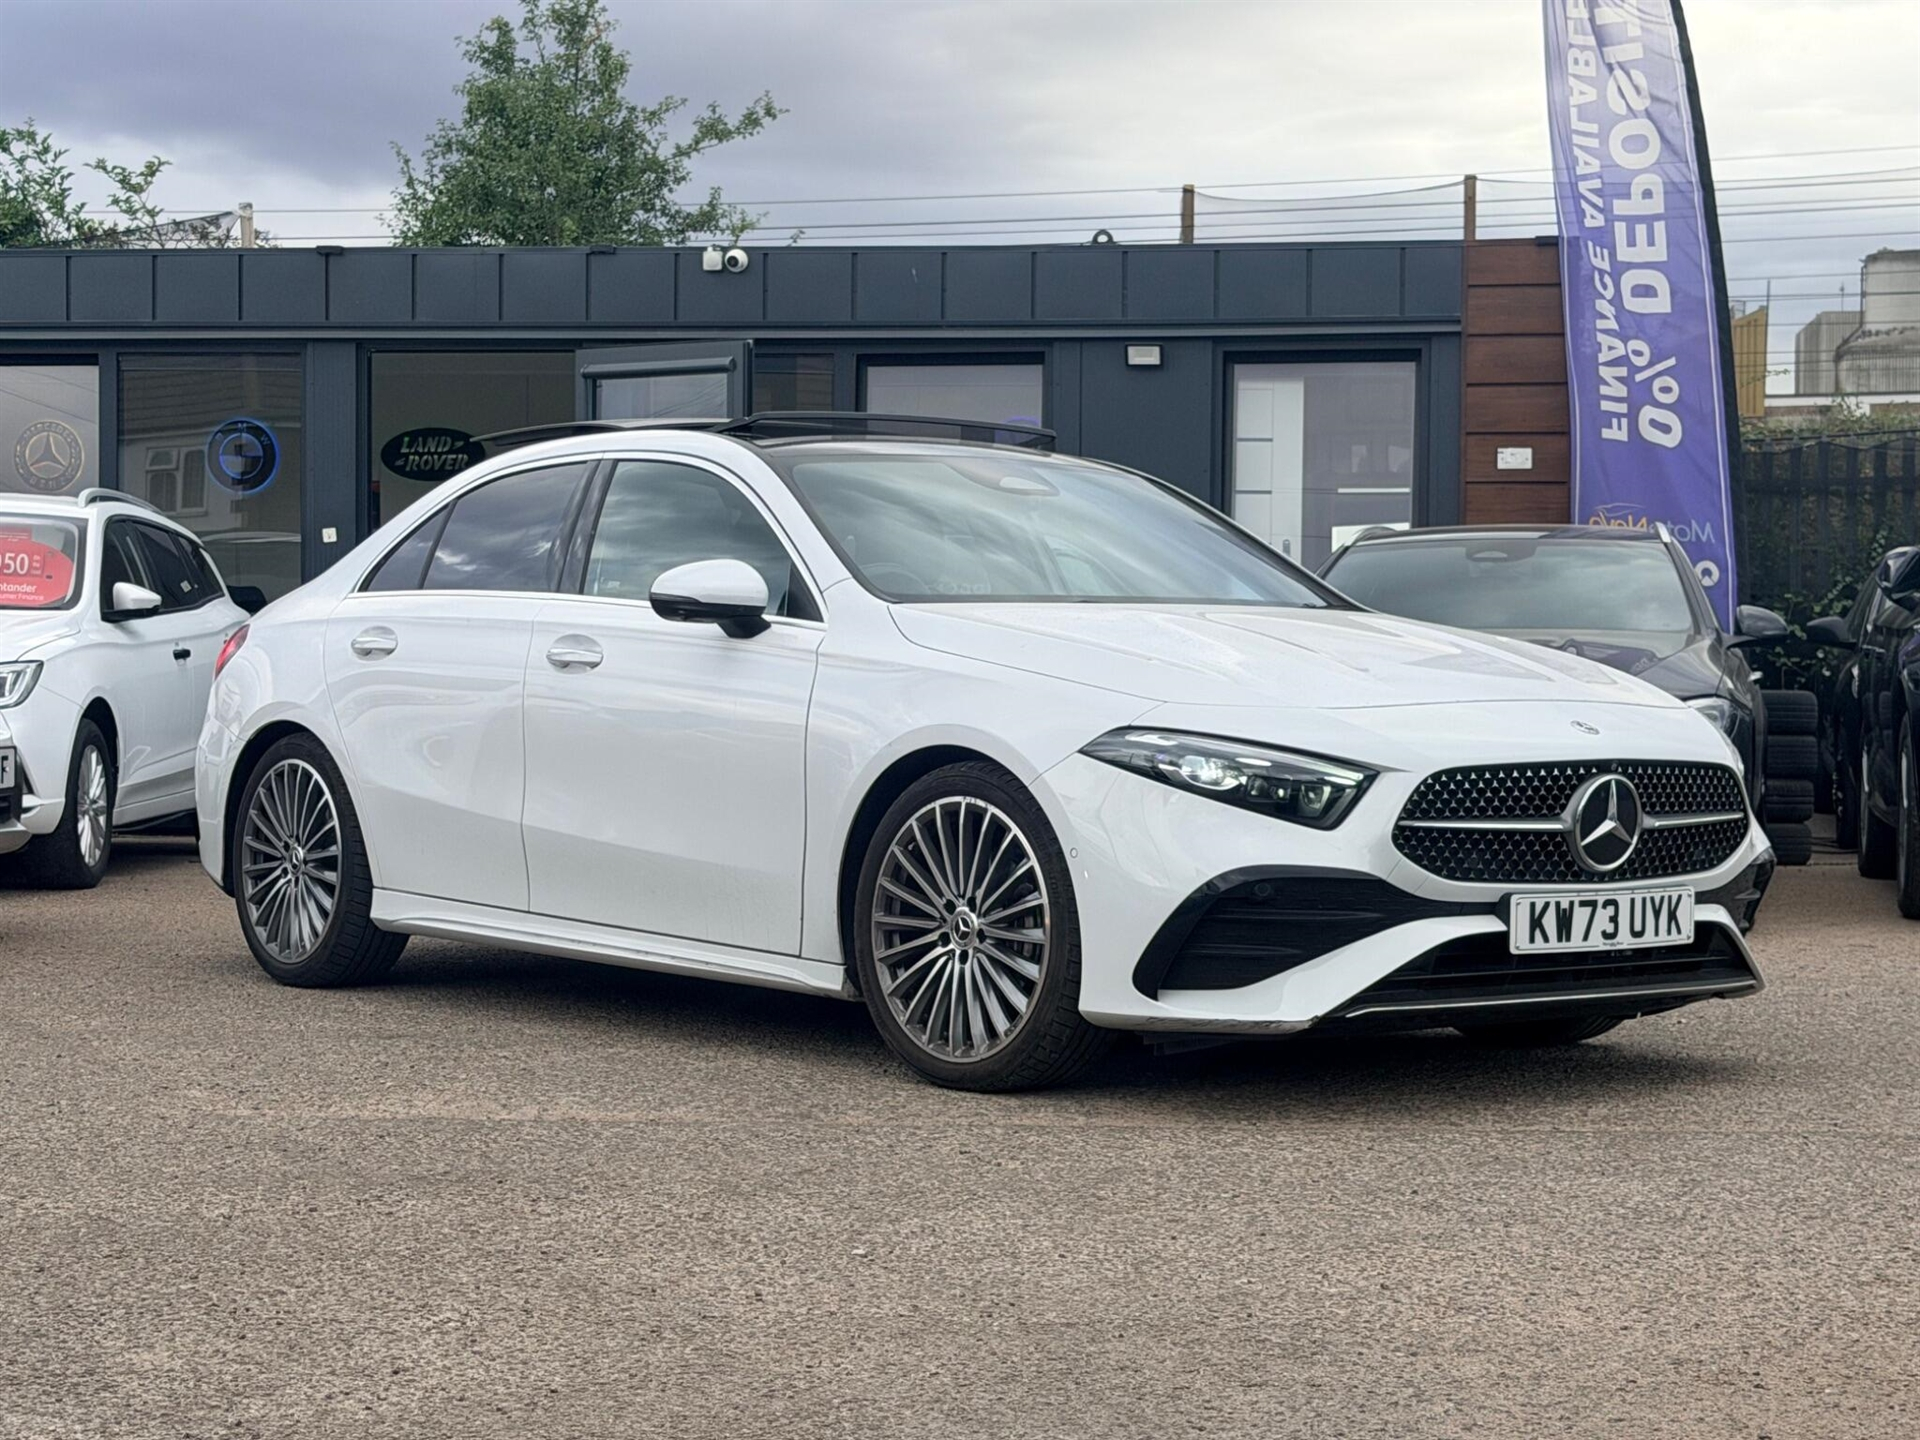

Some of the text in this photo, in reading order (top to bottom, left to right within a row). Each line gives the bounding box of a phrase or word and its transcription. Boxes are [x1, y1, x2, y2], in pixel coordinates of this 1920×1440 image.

[400, 435, 453, 453] LAND
[404, 453, 470, 472] ROVER
[0, 552, 29, 575] 50
[1528, 893, 1683, 945] KW73 UYK
